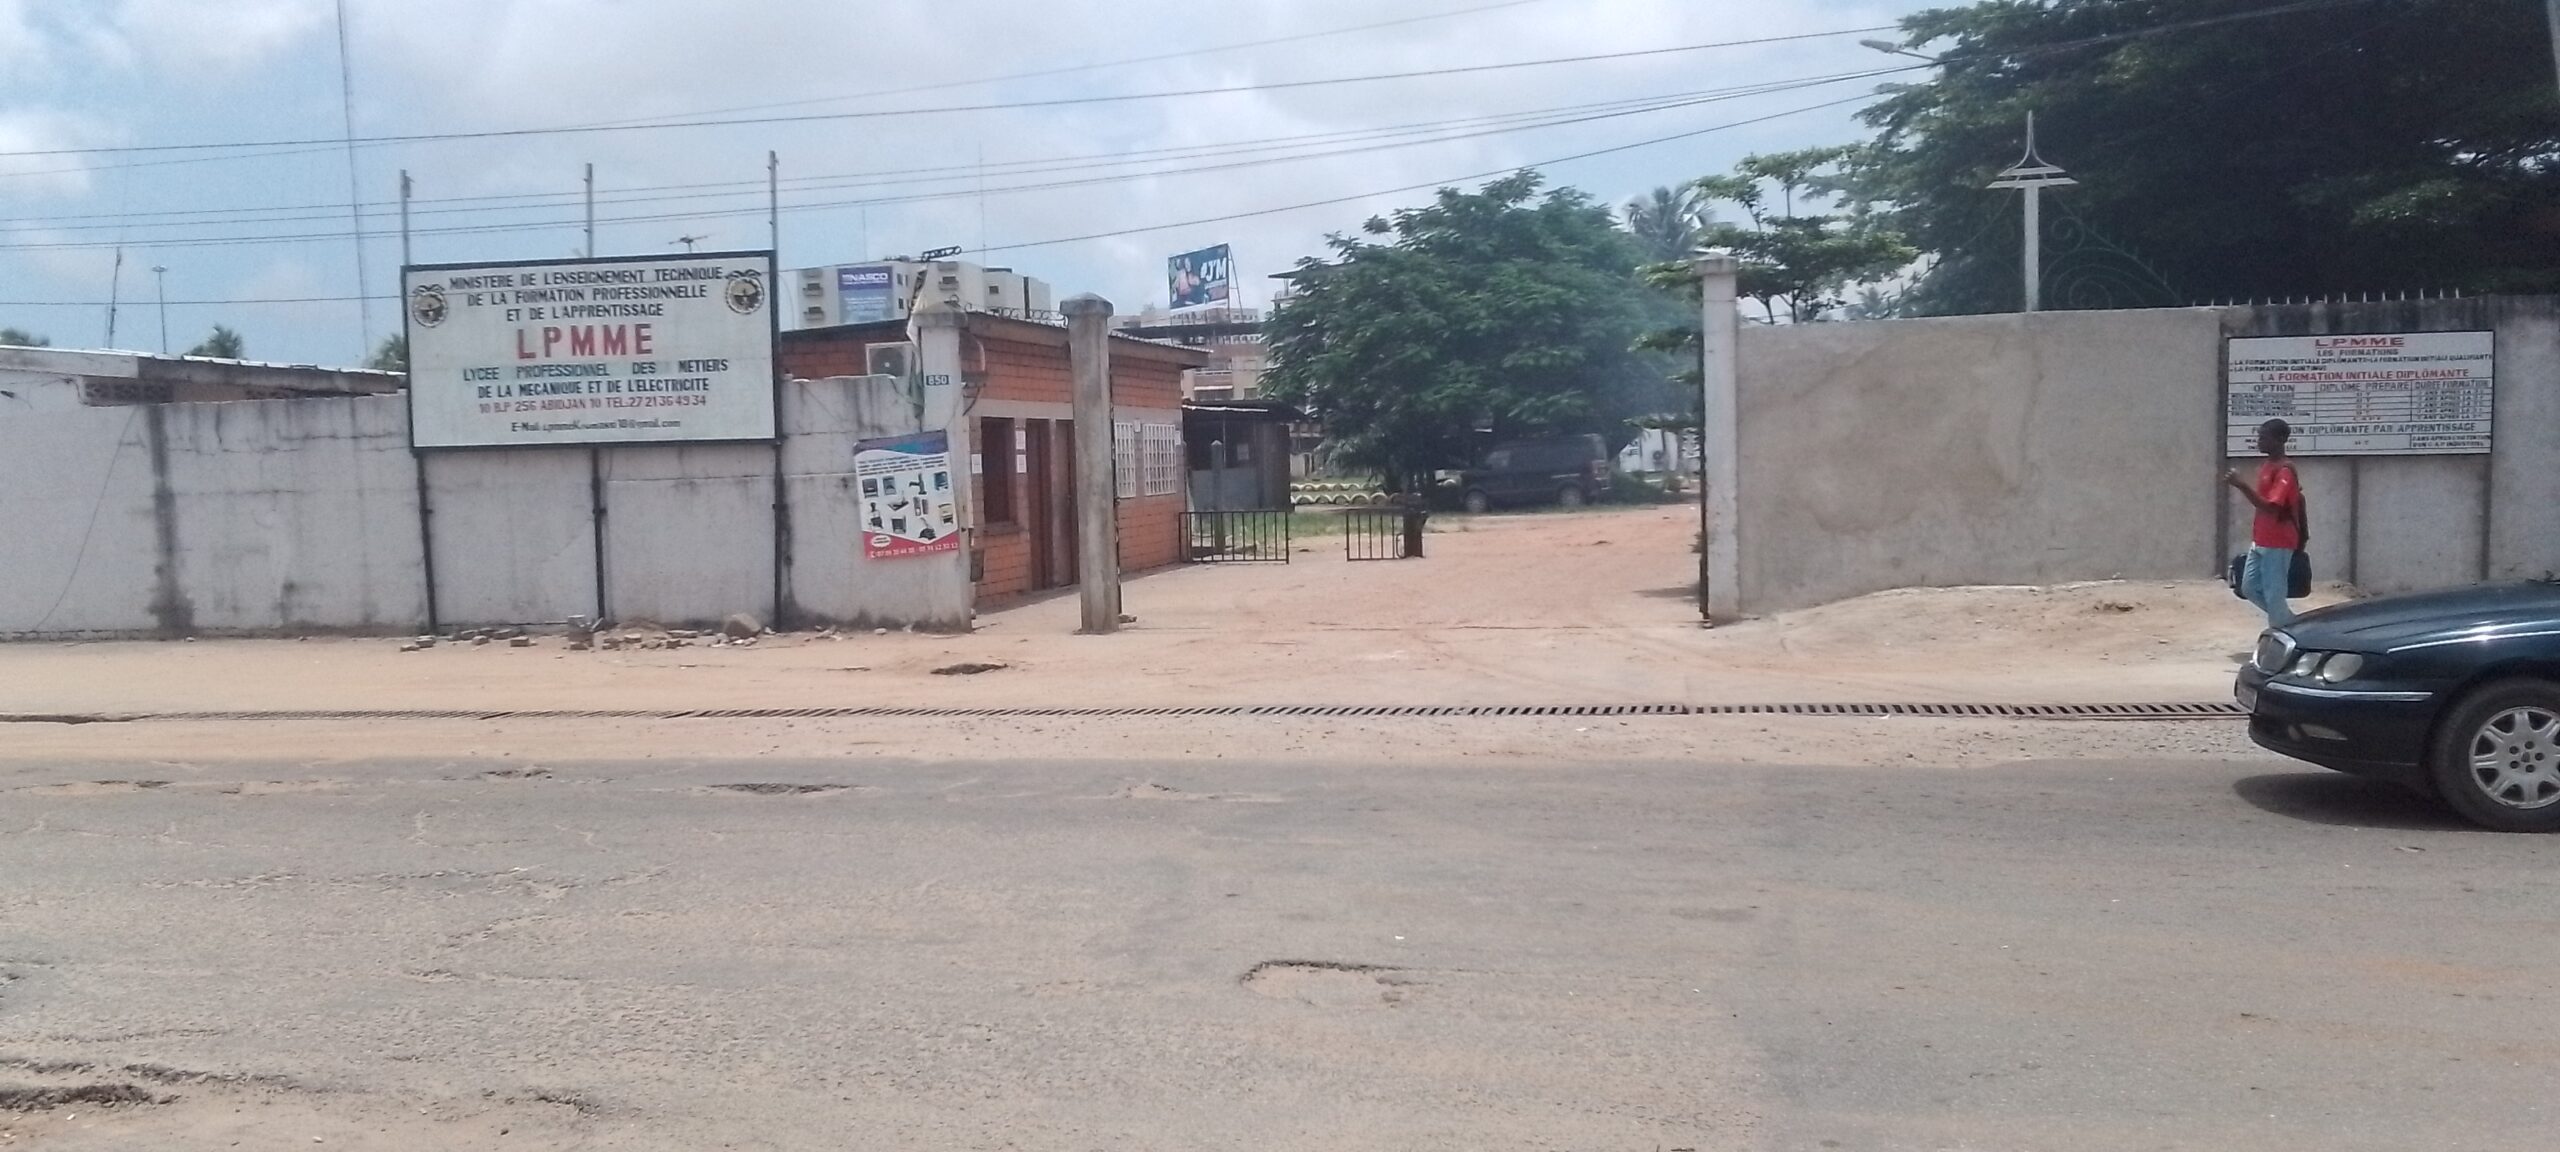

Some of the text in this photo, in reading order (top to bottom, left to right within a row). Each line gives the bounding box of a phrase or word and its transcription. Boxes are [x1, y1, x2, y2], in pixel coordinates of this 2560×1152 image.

[449, 275, 514, 290] MINISTERE
[521, 273, 536, 287] DE
[655, 267, 723, 281] TECHNIQUE
[850, 273, 888, 281] NASCO
[468, 285, 708, 306] DE LA FORMATION PROFESSIONNELLE
[507, 308, 521, 321] ET
[529, 307, 544, 320] DE
[517, 323, 653, 359] LPMME
[2315, 337, 2404, 347] LPMME
[464, 359, 729, 381] LYCEE PROFESSIONNEL DES METIERS
[2261, 373, 2275, 381] LA
[2279, 372, 2343, 381] FORMATION
[2346, 371, 2393, 380] INITIALE
[928, 376, 947, 385] 850
[478, 386, 492, 398] DE
[498, 384, 512, 397] LA
[519, 381, 582, 396] MECANIQUE
[588, 381, 602, 393] ET
[607, 380, 621, 393] DE
[480, 403, 491, 414] 10
[515, 400, 537, 412] 256
[541, 398, 586, 411] ABIDJAN
[590, 398, 602, 409] 10
[2373, 425, 2393, 433] PAR
[2398, 422, 2477, 433] APPRENTISSAGE
